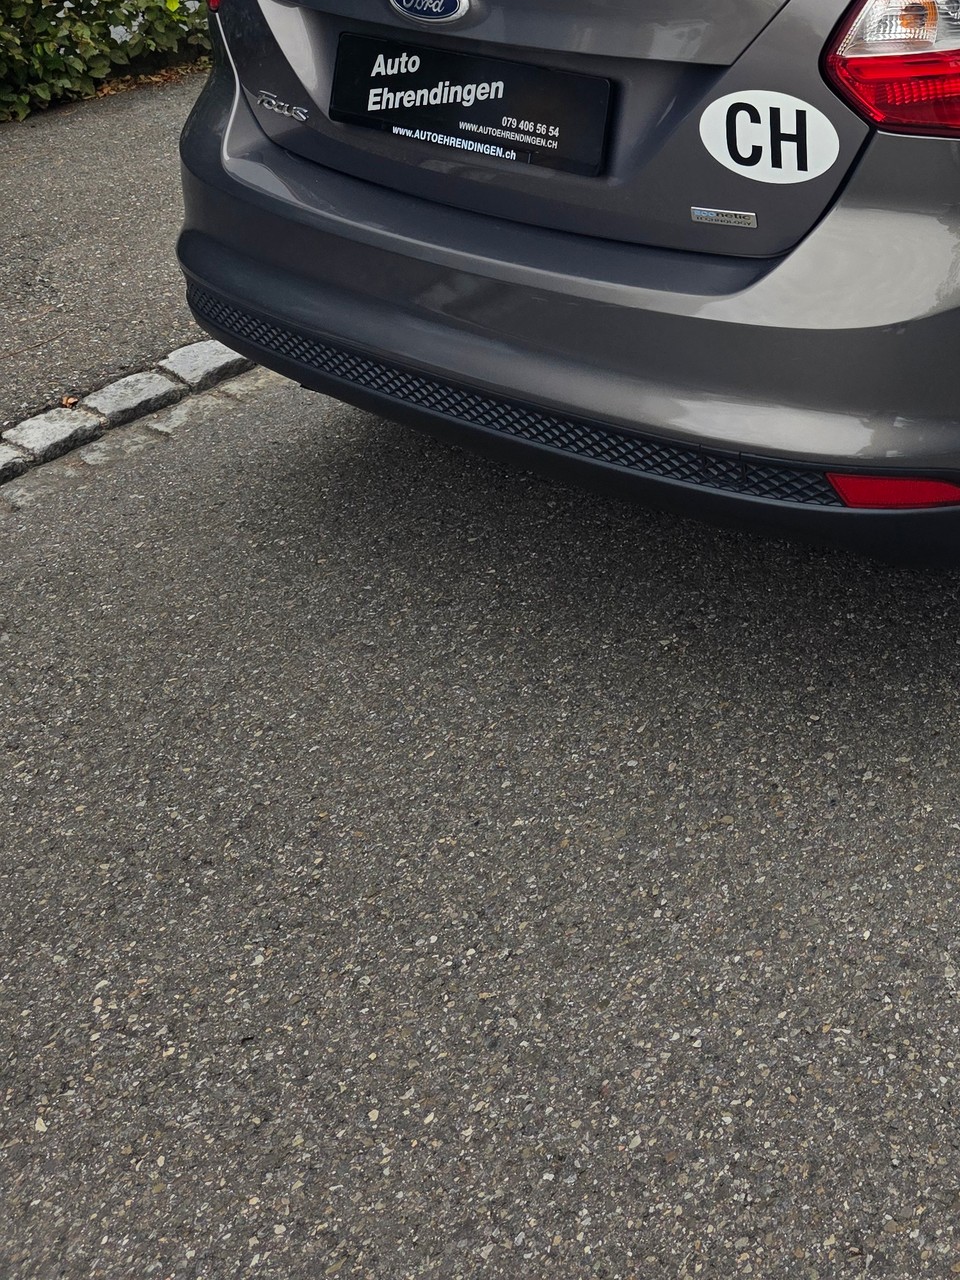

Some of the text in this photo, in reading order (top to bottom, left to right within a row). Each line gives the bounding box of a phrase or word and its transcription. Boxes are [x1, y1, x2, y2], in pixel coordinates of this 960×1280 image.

[370, 52, 421, 77] Auto
[367, 80, 505, 111] Ehrendingen
[459, 121, 558, 149] WWW.AUTOEHRENDINGEN.CH
[501, 116, 560, 138] 079 406 56 54
[725, 102, 808, 172] CH
[392, 125, 517, 161] www.AUTOEHRENDINGEN.ch
